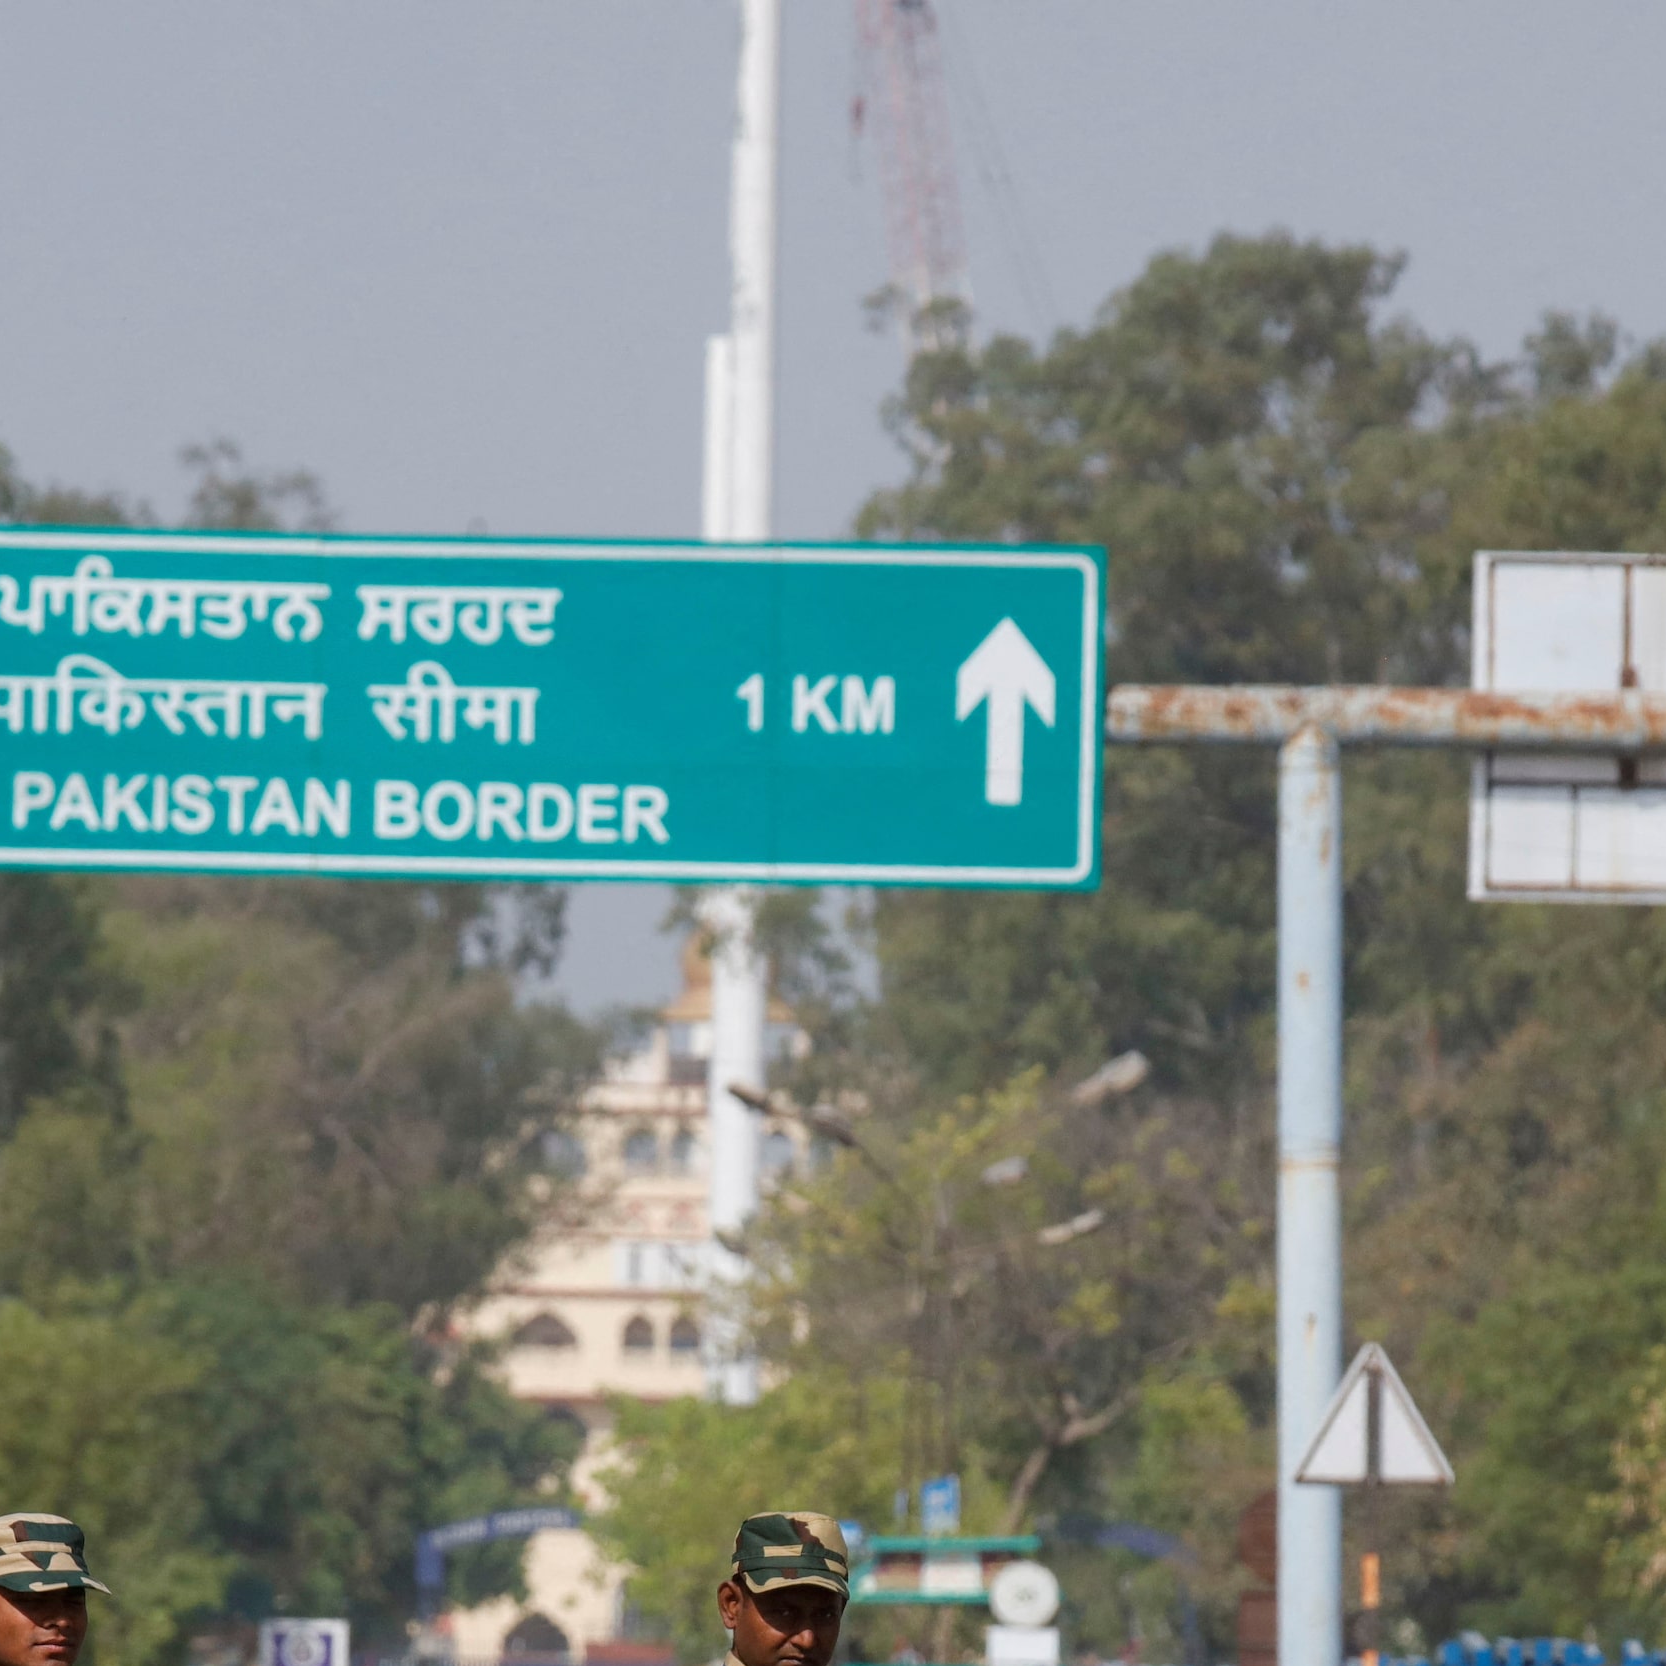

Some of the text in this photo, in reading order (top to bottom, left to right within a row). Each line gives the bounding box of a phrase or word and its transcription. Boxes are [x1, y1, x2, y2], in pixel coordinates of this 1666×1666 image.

[367, 660, 539, 746] सीमा
[736, 672, 896, 735] 1 KM
[12, 771, 352, 838] PAKISTAN
[373, 780, 670, 845] BORDER
